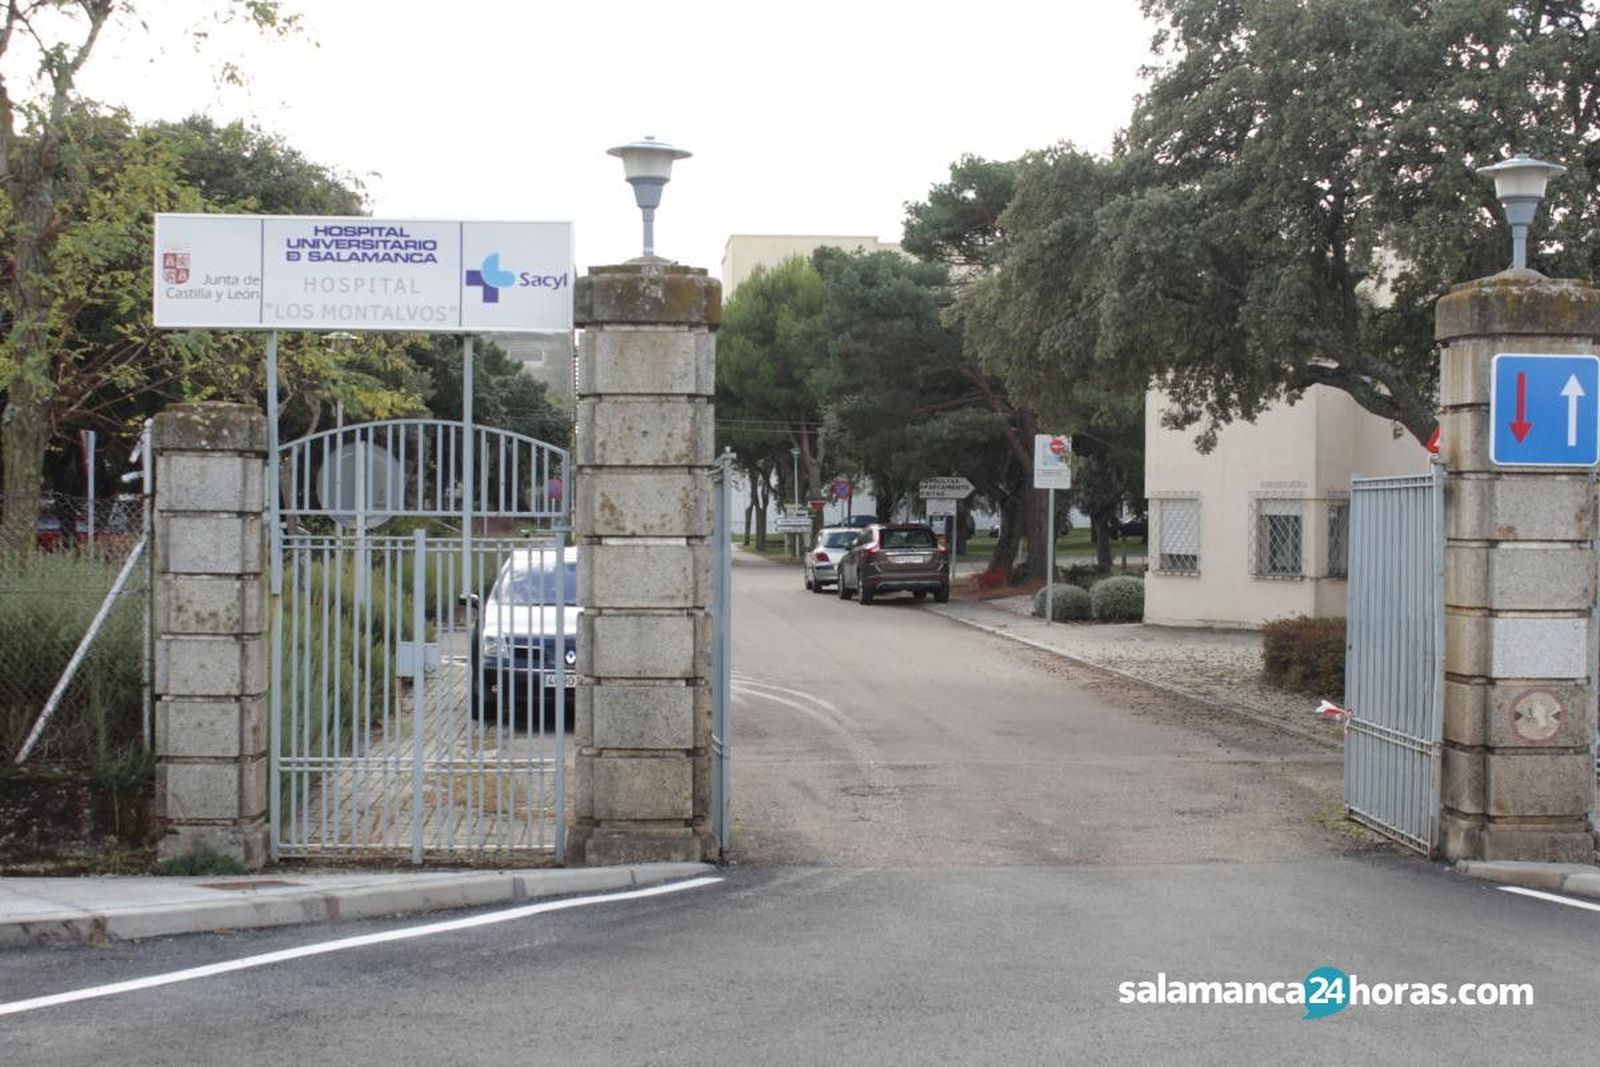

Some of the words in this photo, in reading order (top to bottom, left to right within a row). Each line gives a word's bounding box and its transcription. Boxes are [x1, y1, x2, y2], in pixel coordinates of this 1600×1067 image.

[314, 226, 410, 238] HOSPITAL
[287, 239, 437, 251] UNIVERSITARIO
[308, 251, 437, 263] SALAMANCA
[202, 275, 240, 286] Junta
[243, 275, 260, 286] de
[303, 276, 421, 294] HOSPITAL
[520, 272, 567, 290] Sacyl
[165, 287, 212, 299] Castilla
[215, 290, 224, 303] y
[227, 288, 260, 300] León
